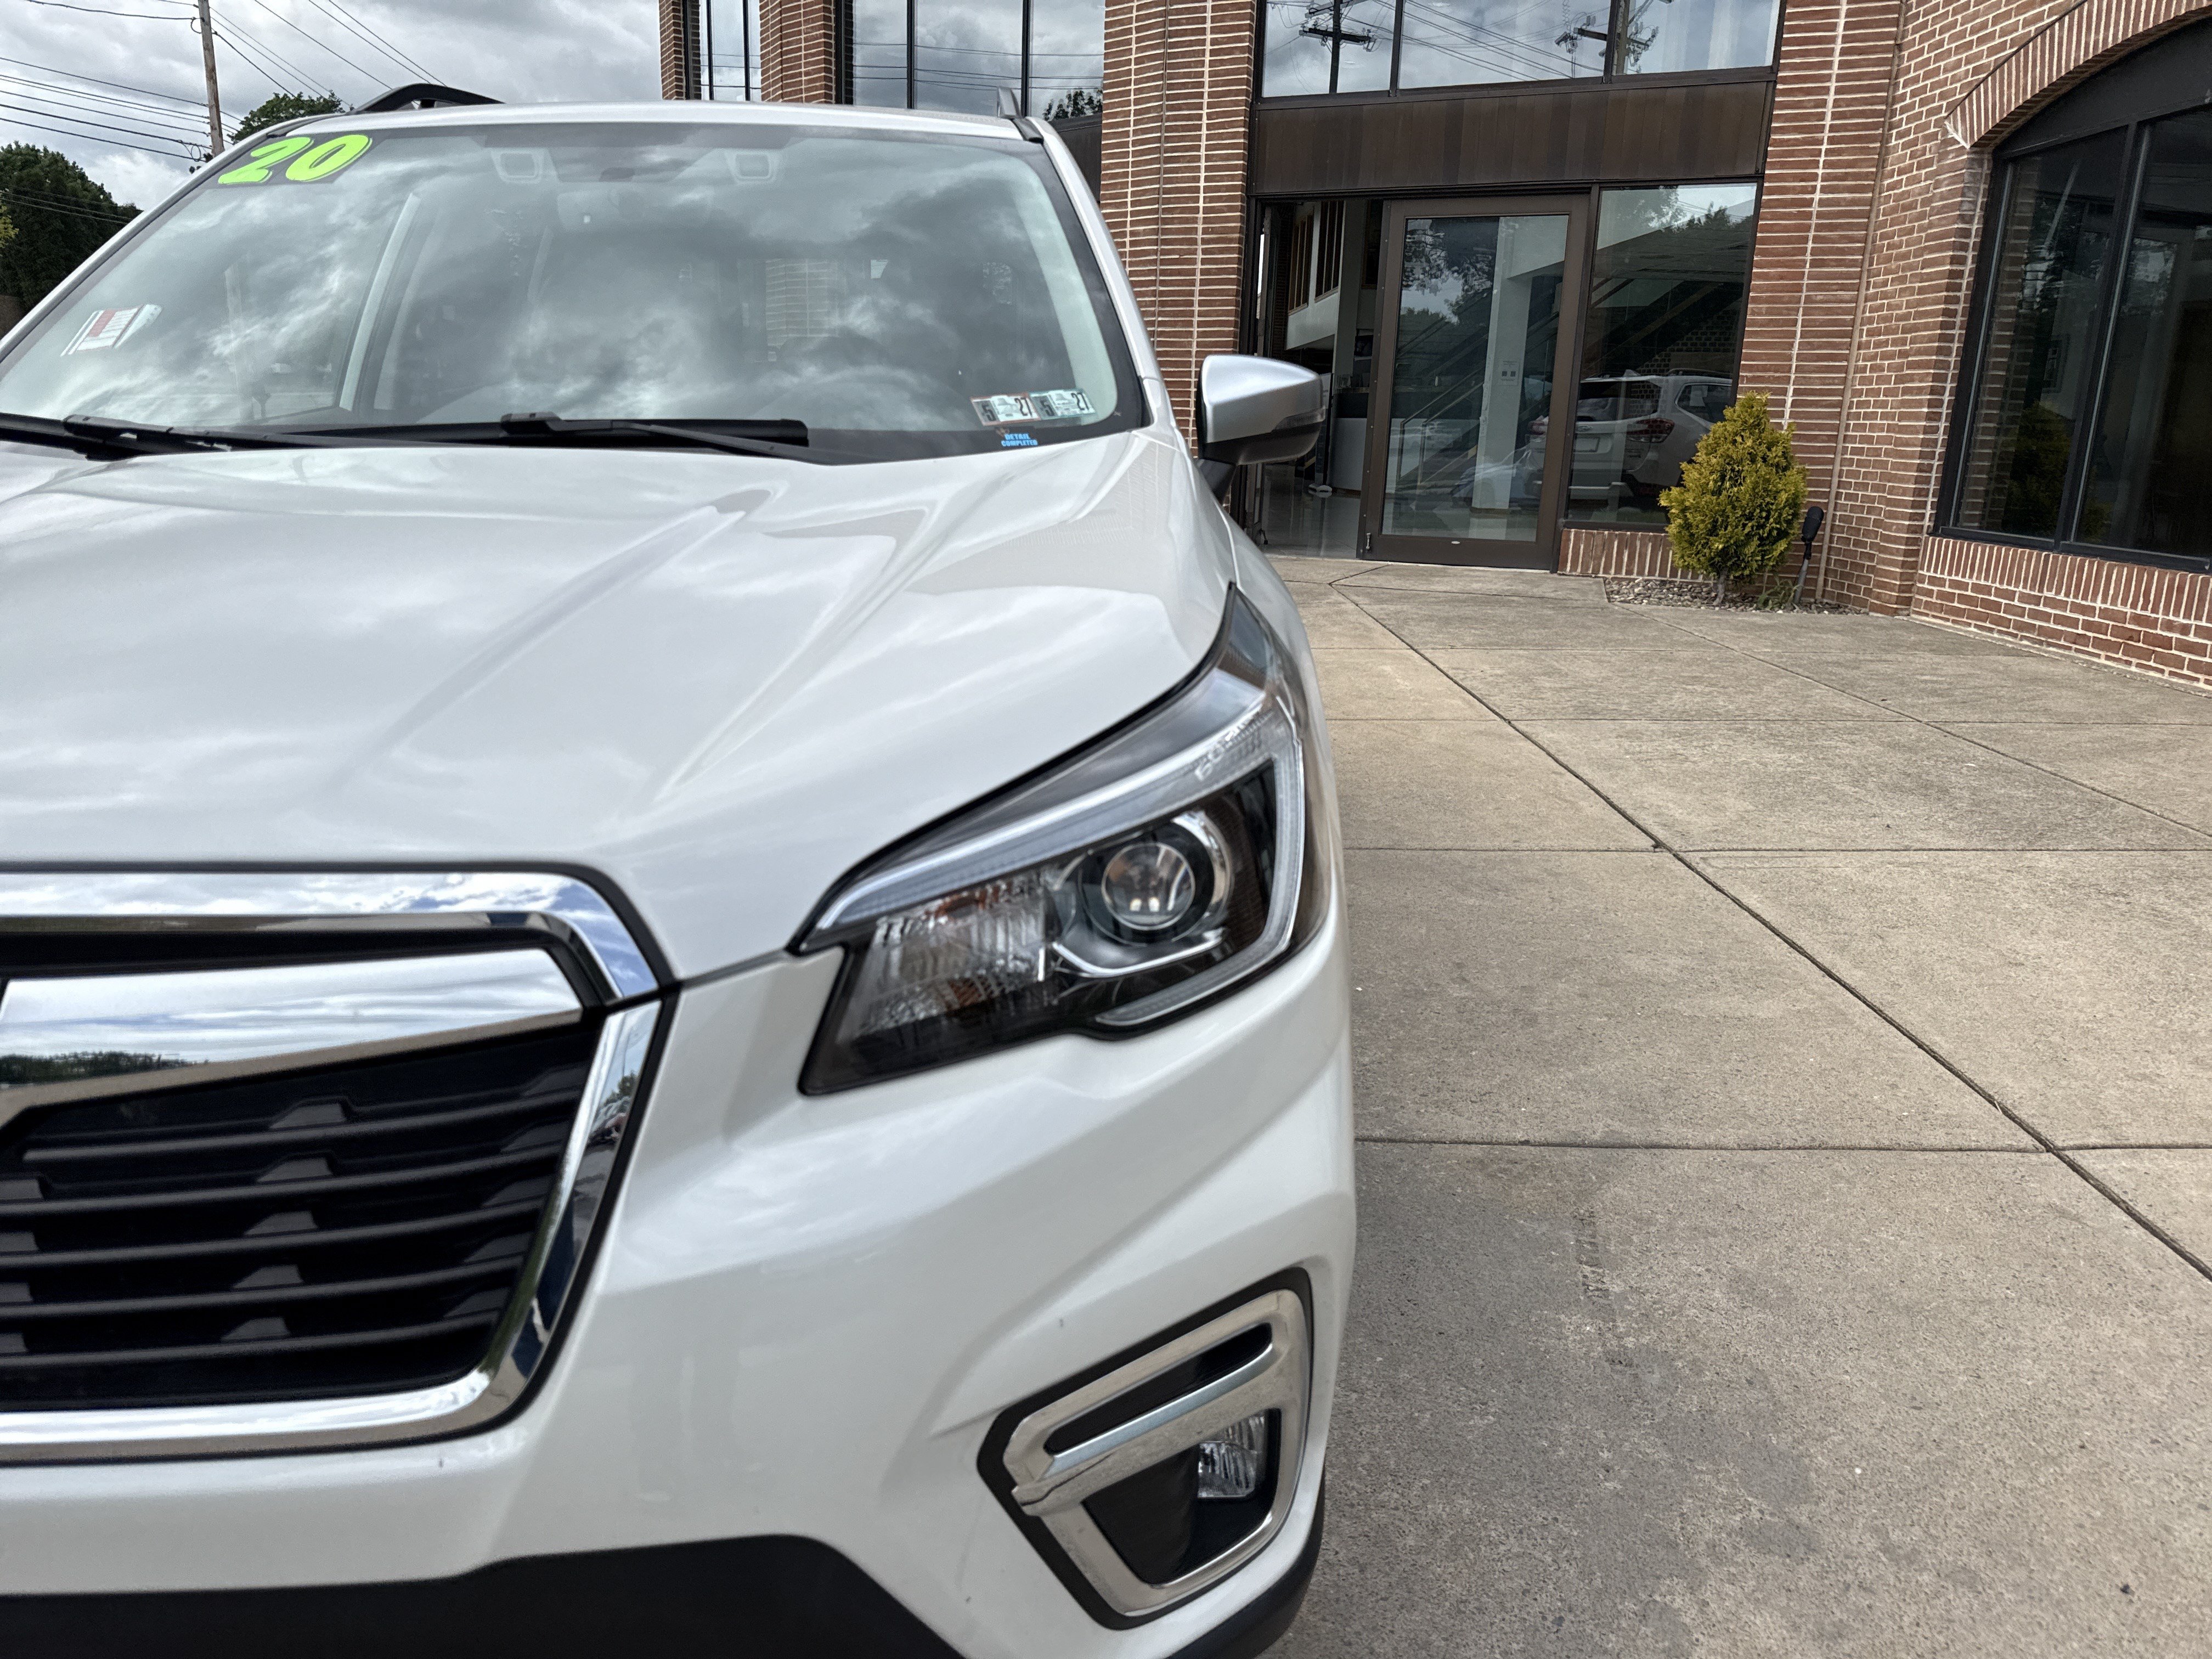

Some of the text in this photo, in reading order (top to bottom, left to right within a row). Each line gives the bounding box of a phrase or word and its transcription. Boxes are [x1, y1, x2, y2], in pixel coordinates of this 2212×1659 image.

[218, 135, 372, 184] 20
[982, 397, 1032, 421] 5 27
[1040, 400, 1056, 416] 5
[1071, 393, 1090, 411] 27
